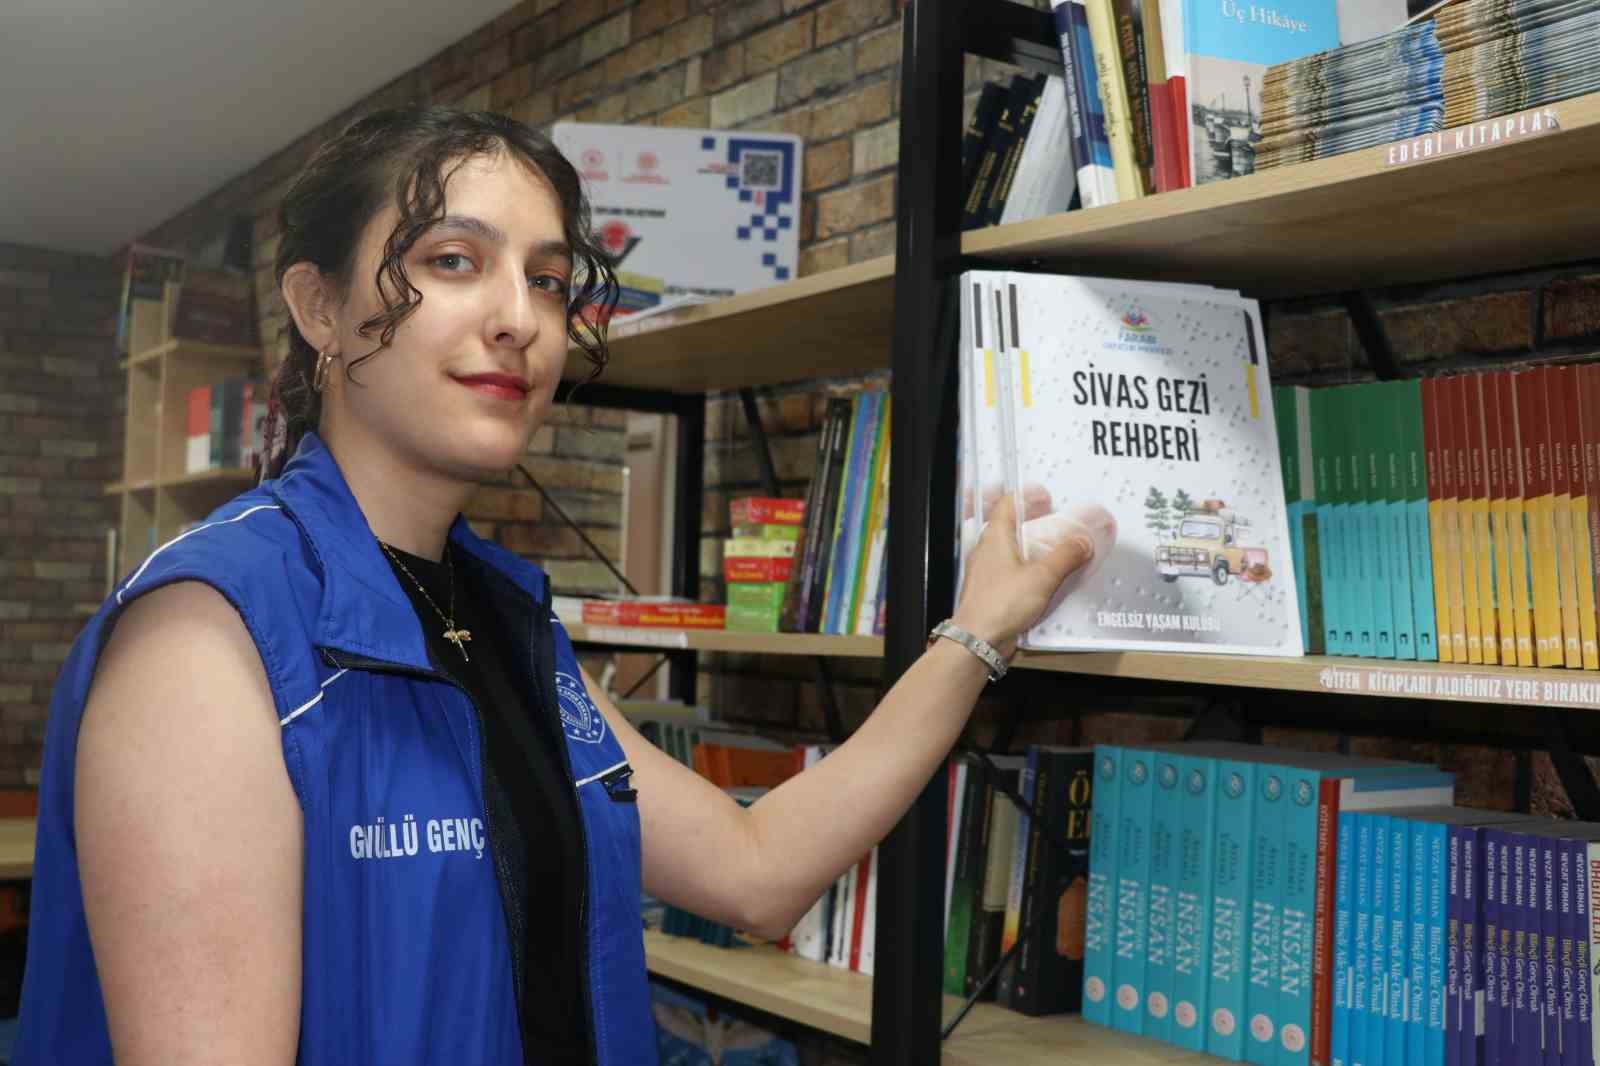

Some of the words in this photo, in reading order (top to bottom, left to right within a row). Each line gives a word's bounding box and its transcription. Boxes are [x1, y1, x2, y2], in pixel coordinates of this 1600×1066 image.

[1389, 132, 1442, 164] EDEBİ
[1073, 362, 1149, 410] SİVAS
[1156, 373, 1210, 415] GEZİ
[1092, 419, 1200, 462] REHBERİ
[1368, 670, 1431, 694] KİTAPLARI
[1435, 673, 1501, 698] ALDIĞINIZ
[1506, 679, 1540, 701] YERE
[426, 817, 485, 859] GENÇ
[1576, 853, 1585, 881] NEVZAT
[1577, 881, 1585, 914] TARHAN
[1428, 926, 1442, 963] Bilinçli
[1431, 967, 1441, 987] Aile
[1546, 964, 1555, 986] Genç
[1562, 967, 1573, 989] Genç
[1577, 969, 1588, 992] Genç
[1430, 991, 1441, 1027] Olmak
[1547, 988, 1556, 1016] Olmak
[1564, 991, 1573, 1019] Olmak
[1579, 993, 1590, 1023] Olmak
